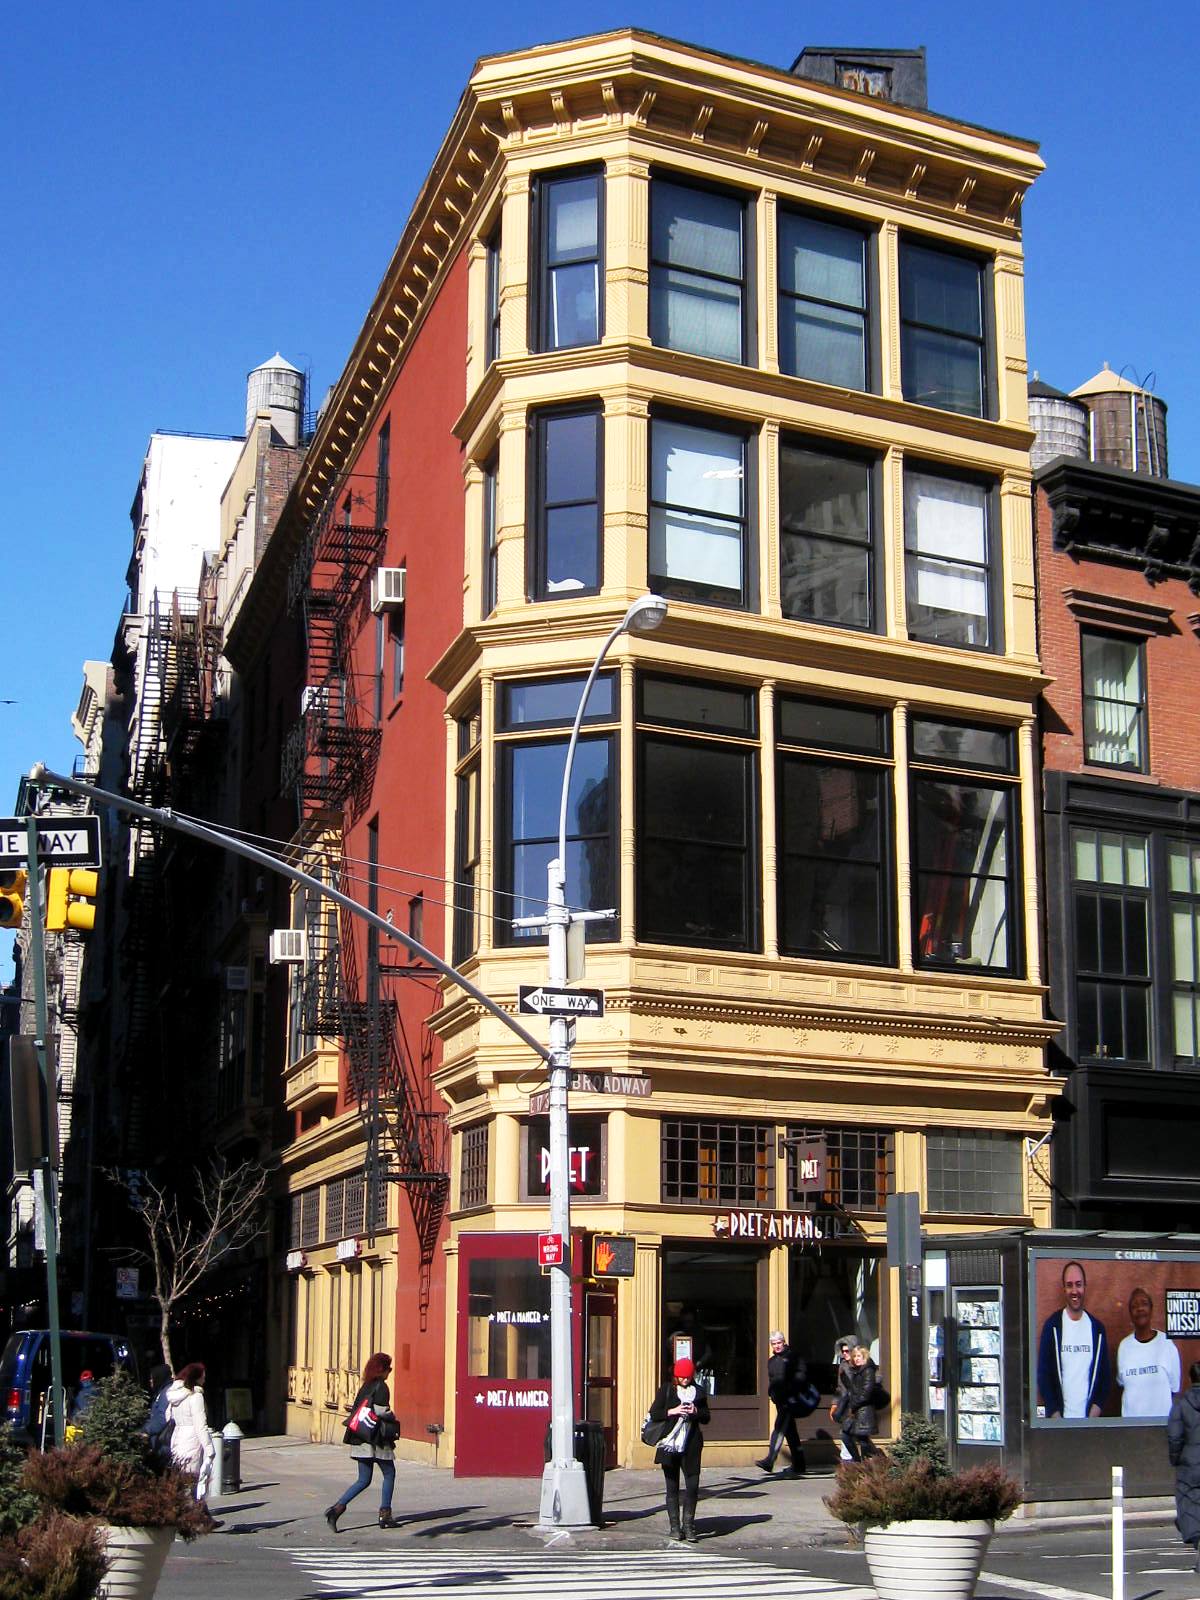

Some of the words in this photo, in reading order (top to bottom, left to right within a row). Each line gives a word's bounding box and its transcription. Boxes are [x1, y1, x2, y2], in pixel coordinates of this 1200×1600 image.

[0, 834, 19, 853] E
[37, 833, 77, 852] WAY
[532, 994, 555, 1007] ONE
[567, 997, 593, 1009] WAY
[571, 1073, 649, 1095] BROADWAY
[541, 1146, 590, 1183] PET
[801, 1159, 818, 1179] PRET
[730, 1212, 763, 1237] PRET
[767, 1214, 777, 1238] A
[782, 1214, 840, 1239] MANGER
[546, 1253, 556, 1261] WAY
[1167, 1299, 1199, 1313] UNITED
[496, 1311, 511, 1323] PRET
[511, 1312, 517, 1323] A
[517, 1311, 541, 1323] MANGER
[1061, 1344, 1072, 1353] LIVE
[1073, 1344, 1091, 1353] UNITED
[1126, 1367, 1137, 1377] LIVE
[1138, 1365, 1158, 1375] UNITED
[487, 1390, 507, 1407] PRET
[507, 1391, 514, 1407] A
[515, 1390, 549, 1407] MANGER
